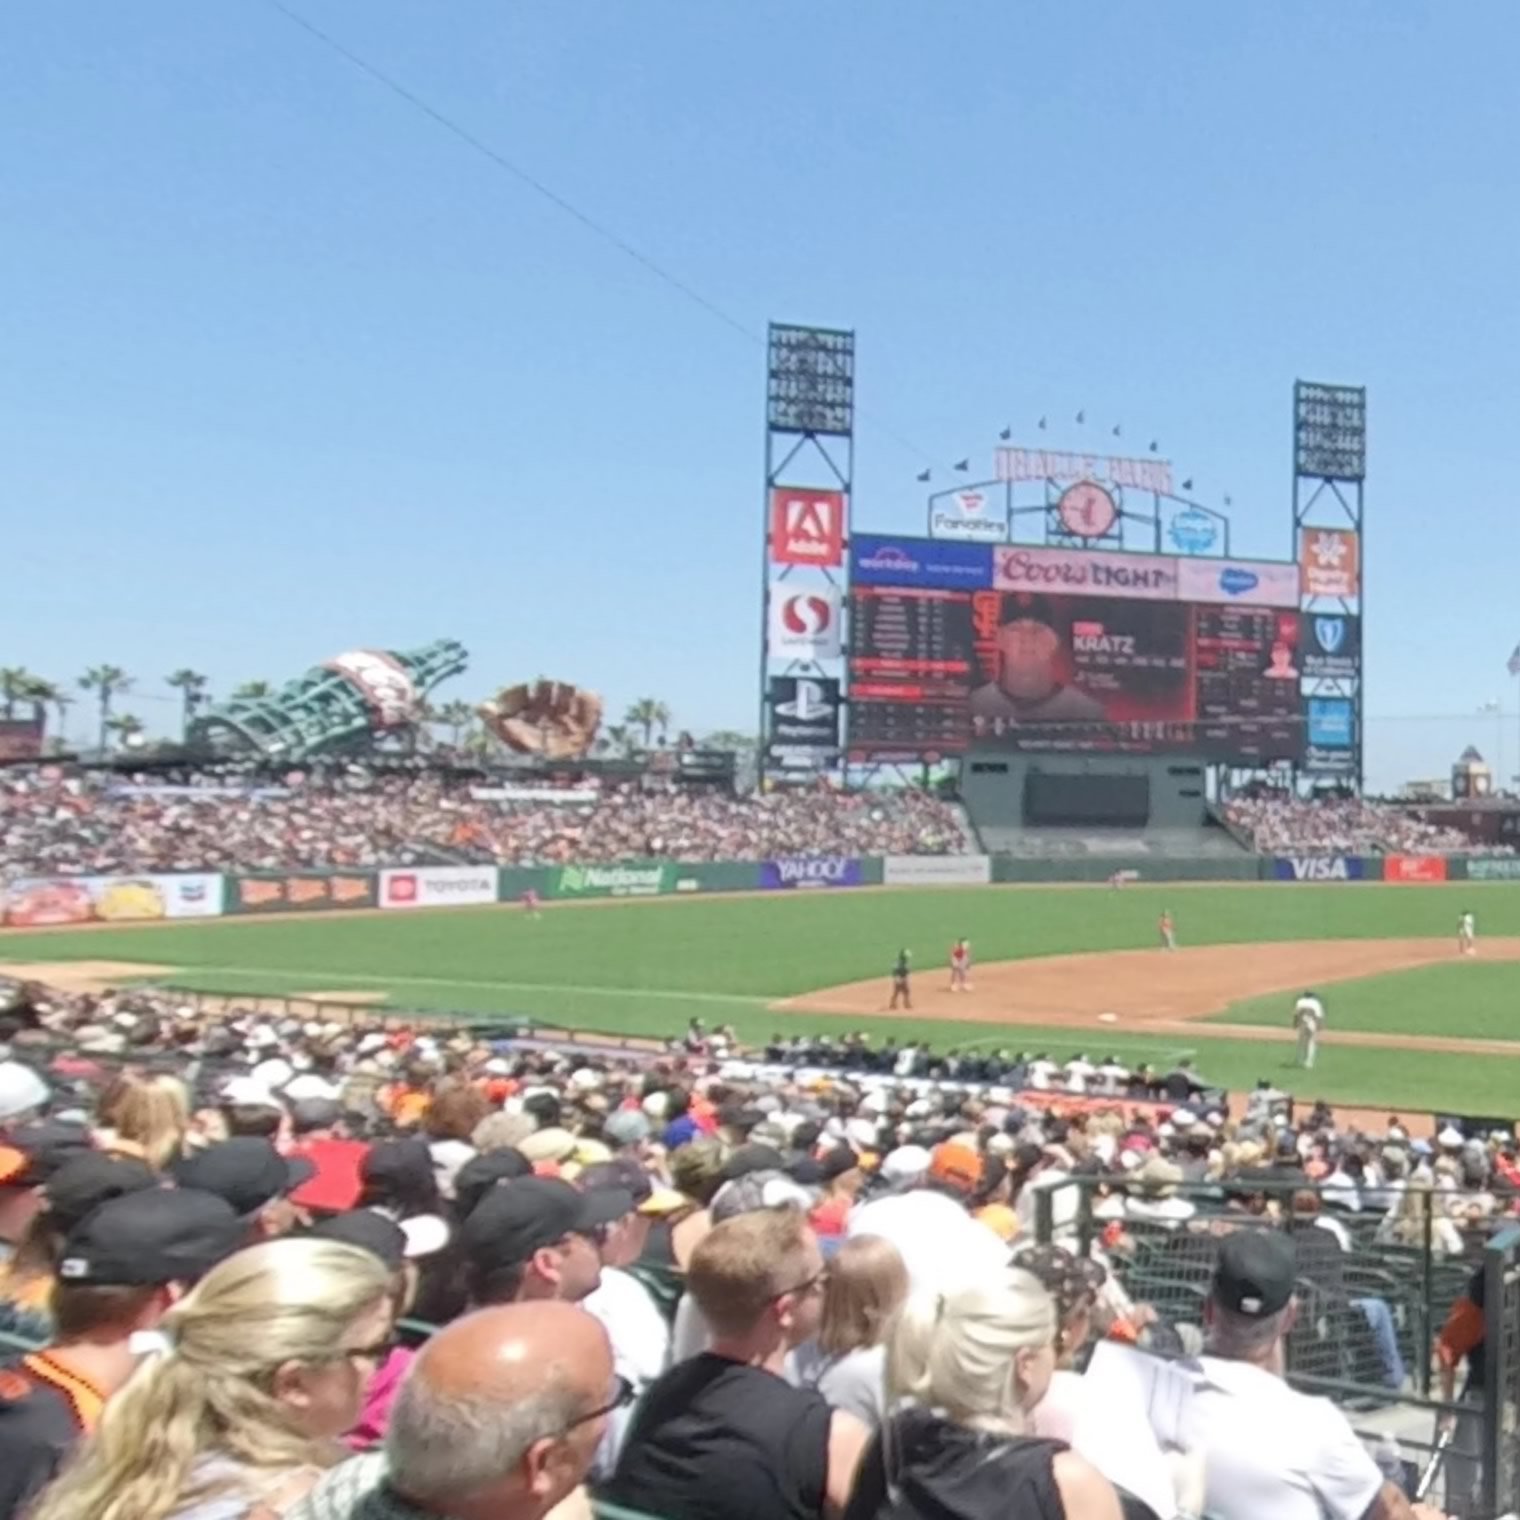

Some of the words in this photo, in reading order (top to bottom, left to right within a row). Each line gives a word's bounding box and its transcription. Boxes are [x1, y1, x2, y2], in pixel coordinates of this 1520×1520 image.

[1001, 550, 1088, 583] Coors
[1091, 562, 1164, 589] LIGHT
[1073, 635, 1135, 654] KRATZ
[584, 866, 663, 887] National
[1290, 857, 1348, 879] VISA
[426, 880, 491, 894] TOYOTA
